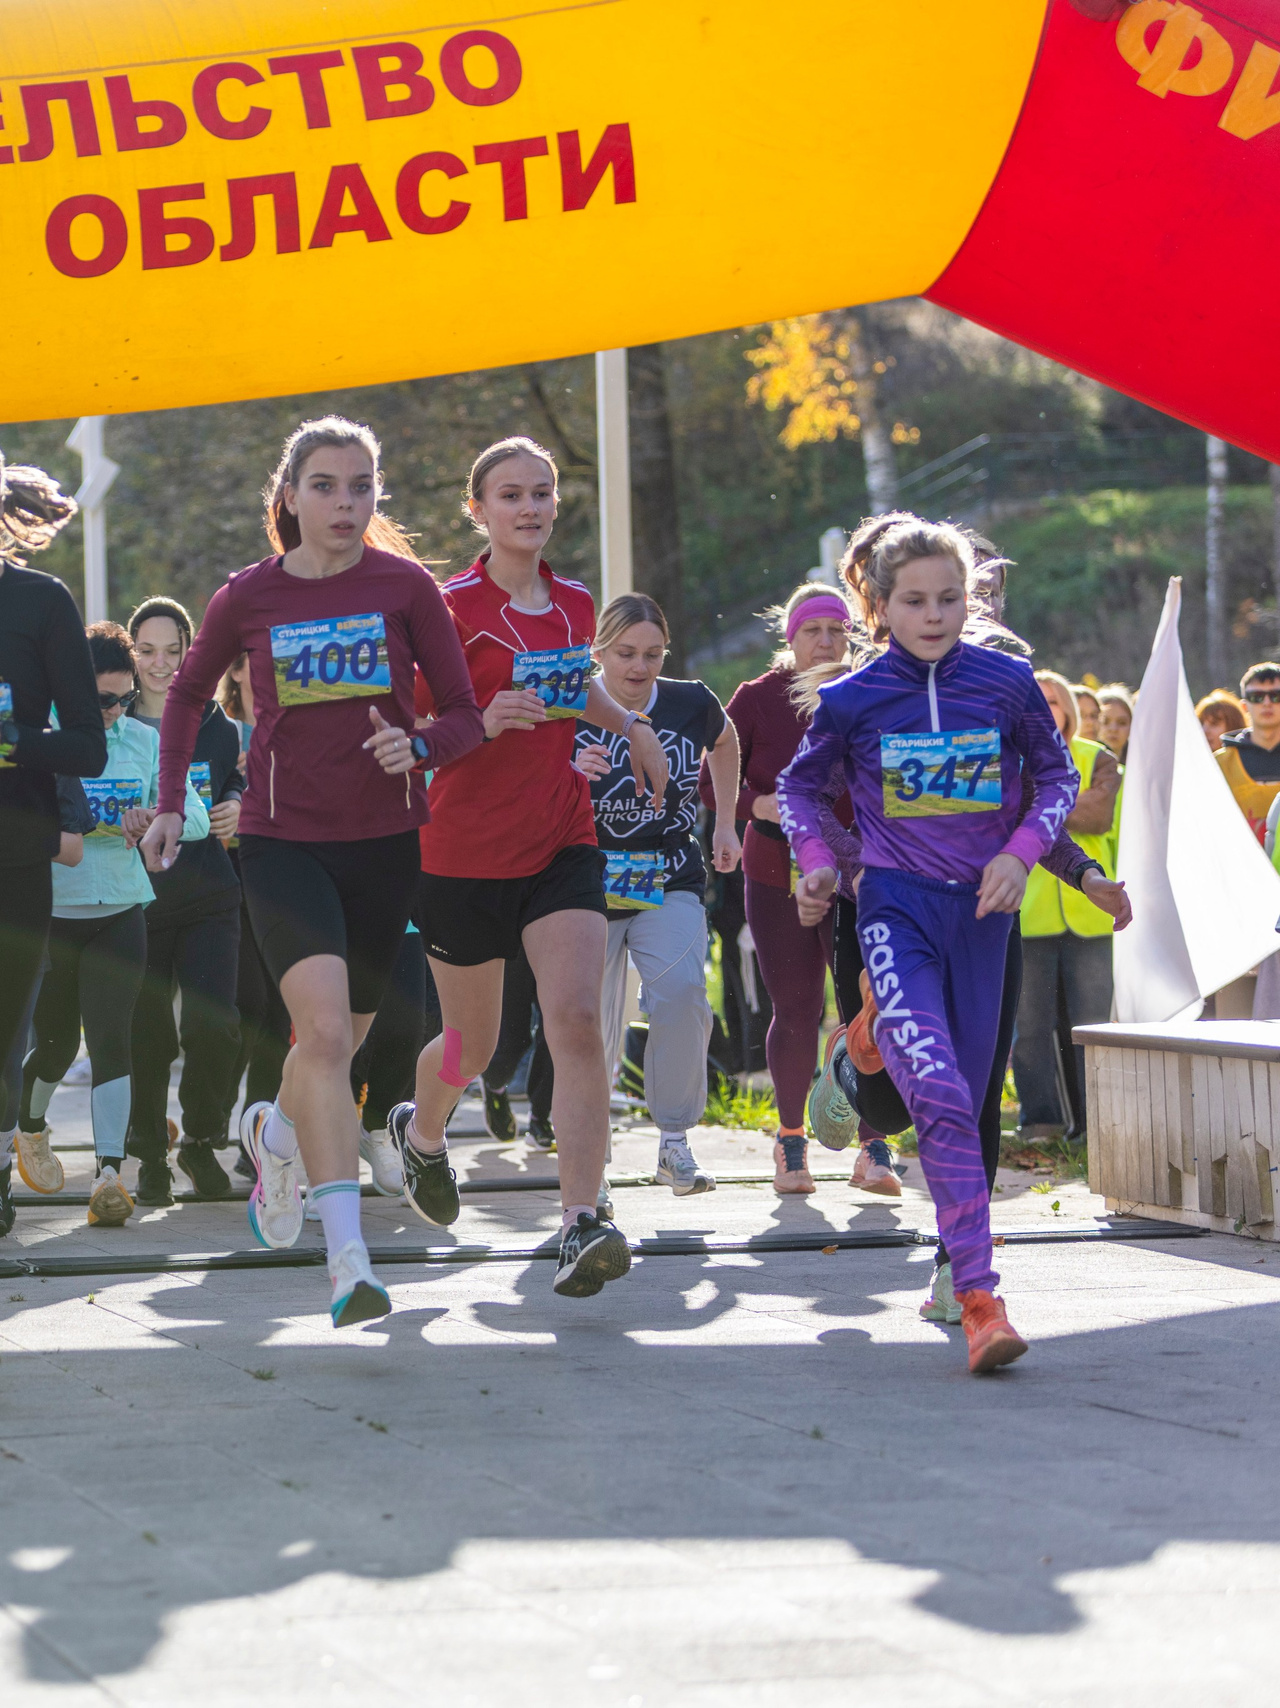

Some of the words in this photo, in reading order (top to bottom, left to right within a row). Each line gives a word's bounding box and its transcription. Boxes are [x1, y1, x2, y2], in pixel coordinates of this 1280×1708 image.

[45, 122, 637, 279] ОБЛАСТИ
[278, 624, 330, 639] СТАРИЦКИЕ
[285, 637, 378, 688] 400
[520, 654, 559, 665] СТАРИЦКИЕ
[889, 737, 945, 749] СТАРИЦКИЕ
[895, 753, 993, 802] 347
[593, 809, 667, 823] УЛКОВО
[863, 922, 946, 1080] easyski
